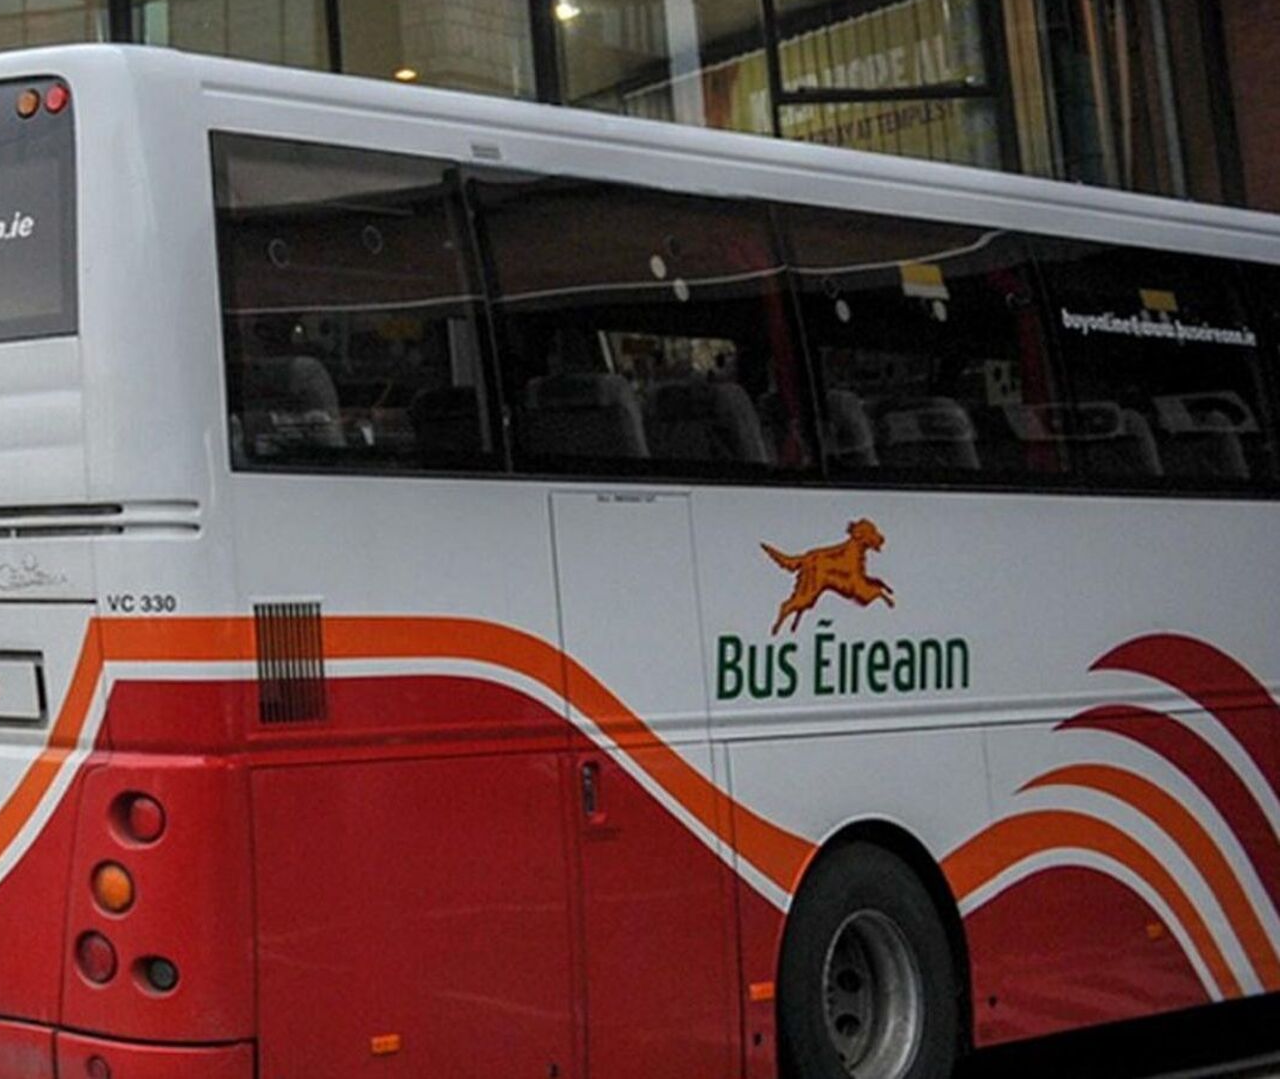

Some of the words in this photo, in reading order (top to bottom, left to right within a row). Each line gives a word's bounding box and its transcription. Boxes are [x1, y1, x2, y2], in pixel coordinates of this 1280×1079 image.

[106, 594, 135, 613] VC
[140, 594, 177, 613] 330
[717, 634, 798, 700] Bus
